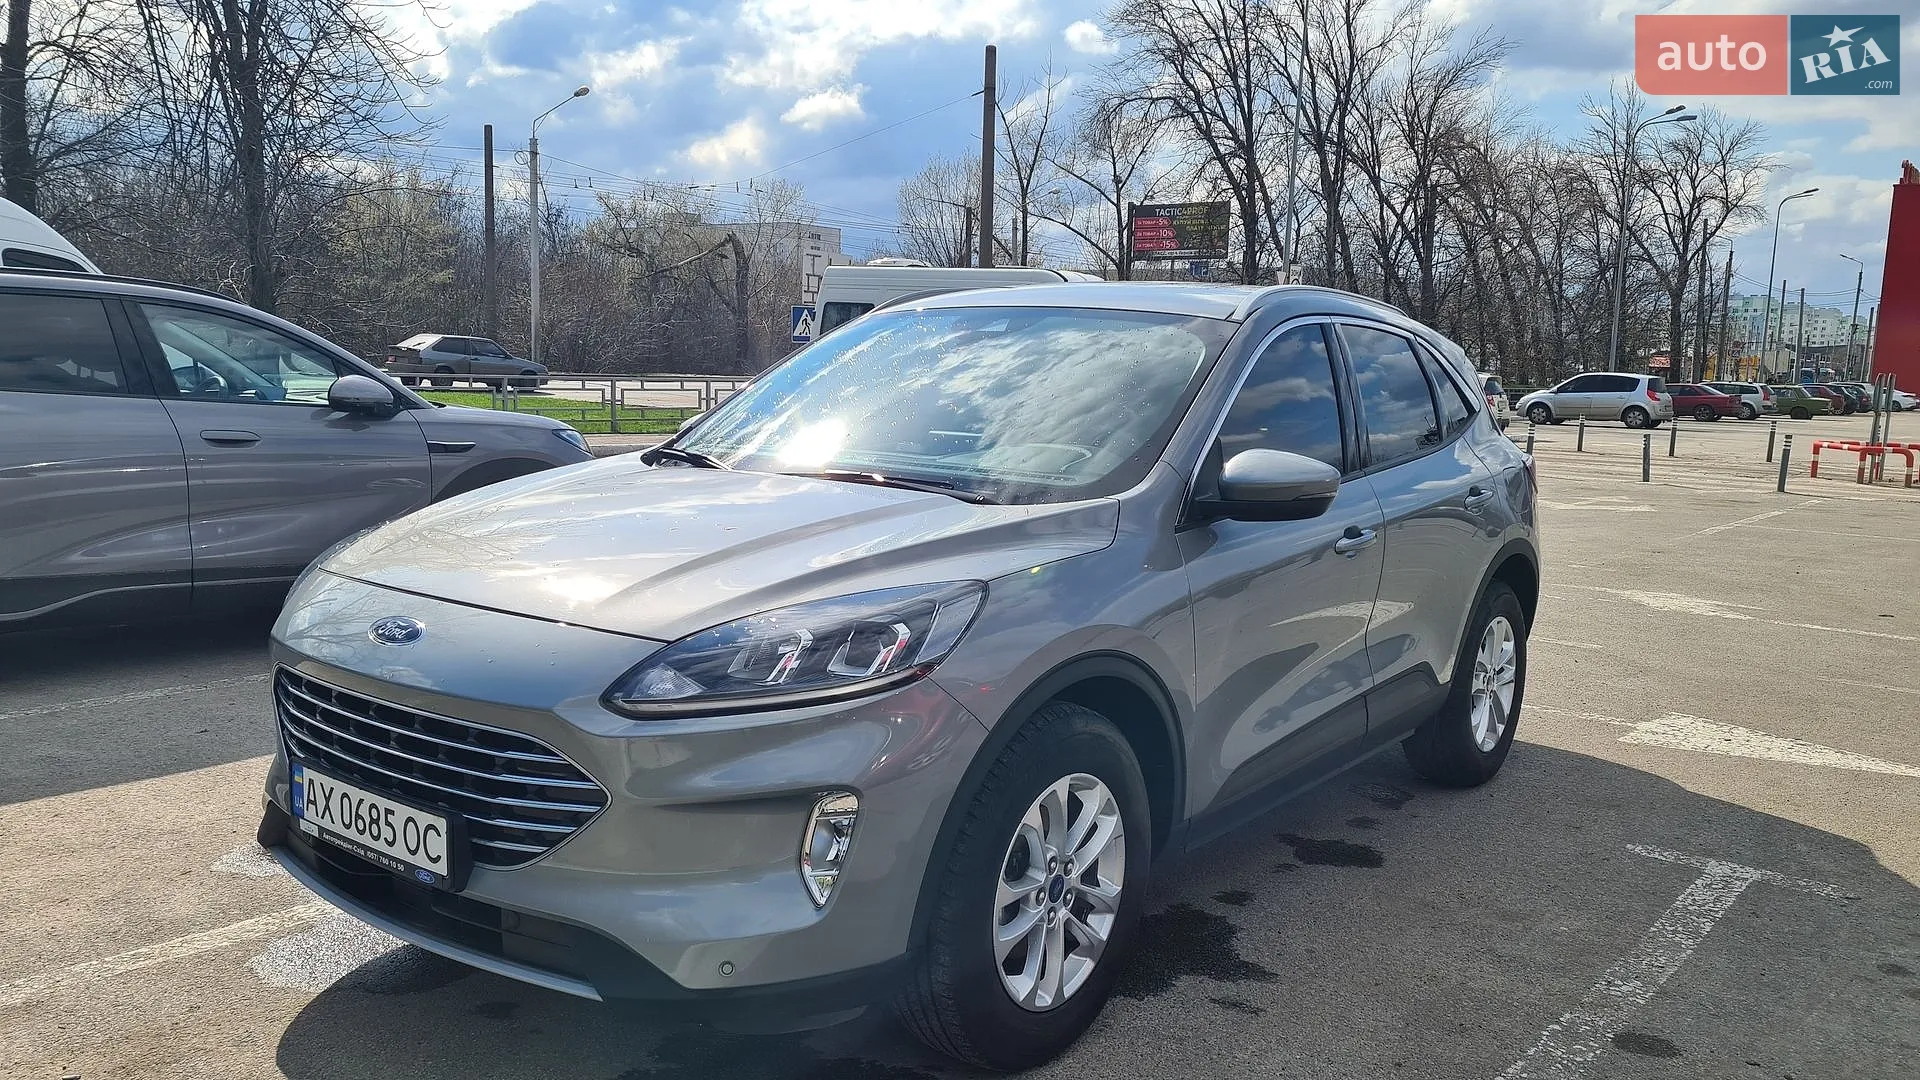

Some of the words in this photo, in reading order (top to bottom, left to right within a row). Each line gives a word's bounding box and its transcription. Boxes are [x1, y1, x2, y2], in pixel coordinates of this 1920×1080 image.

[378, 619, 413, 639] Ford
[294, 795, 304, 809] UA
[305, 778, 335, 825] AX
[340, 791, 397, 848] 0685
[403, 815, 442, 864] OC
